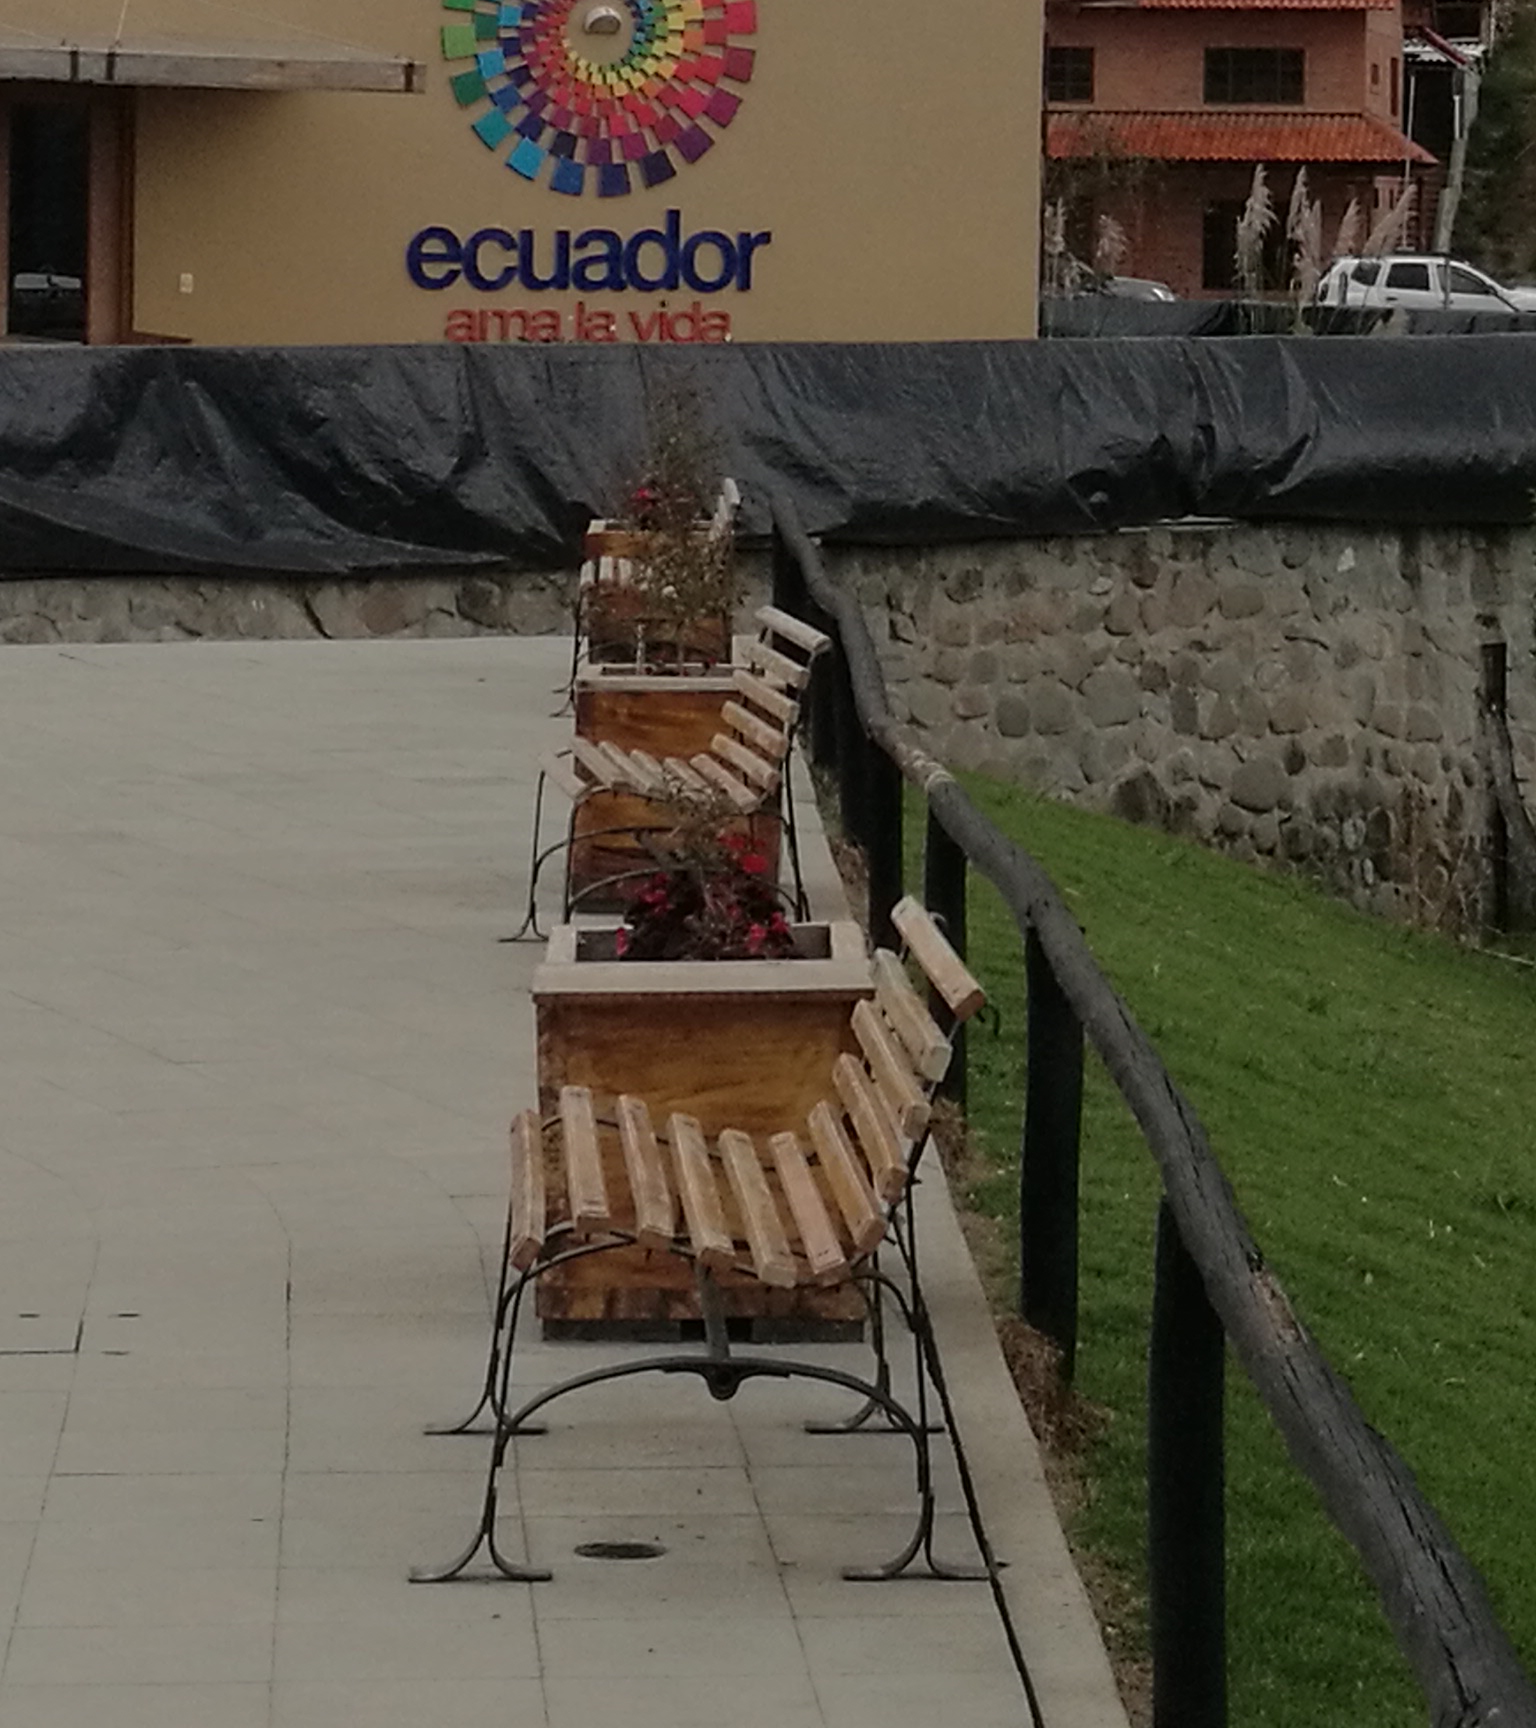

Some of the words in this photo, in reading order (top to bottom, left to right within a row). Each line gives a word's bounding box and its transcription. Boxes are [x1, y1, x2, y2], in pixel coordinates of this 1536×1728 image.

[406, 208, 772, 291] ecuador
[444, 307, 560, 342] ama
[574, 301, 616, 342] la
[628, 301, 732, 342] vida
